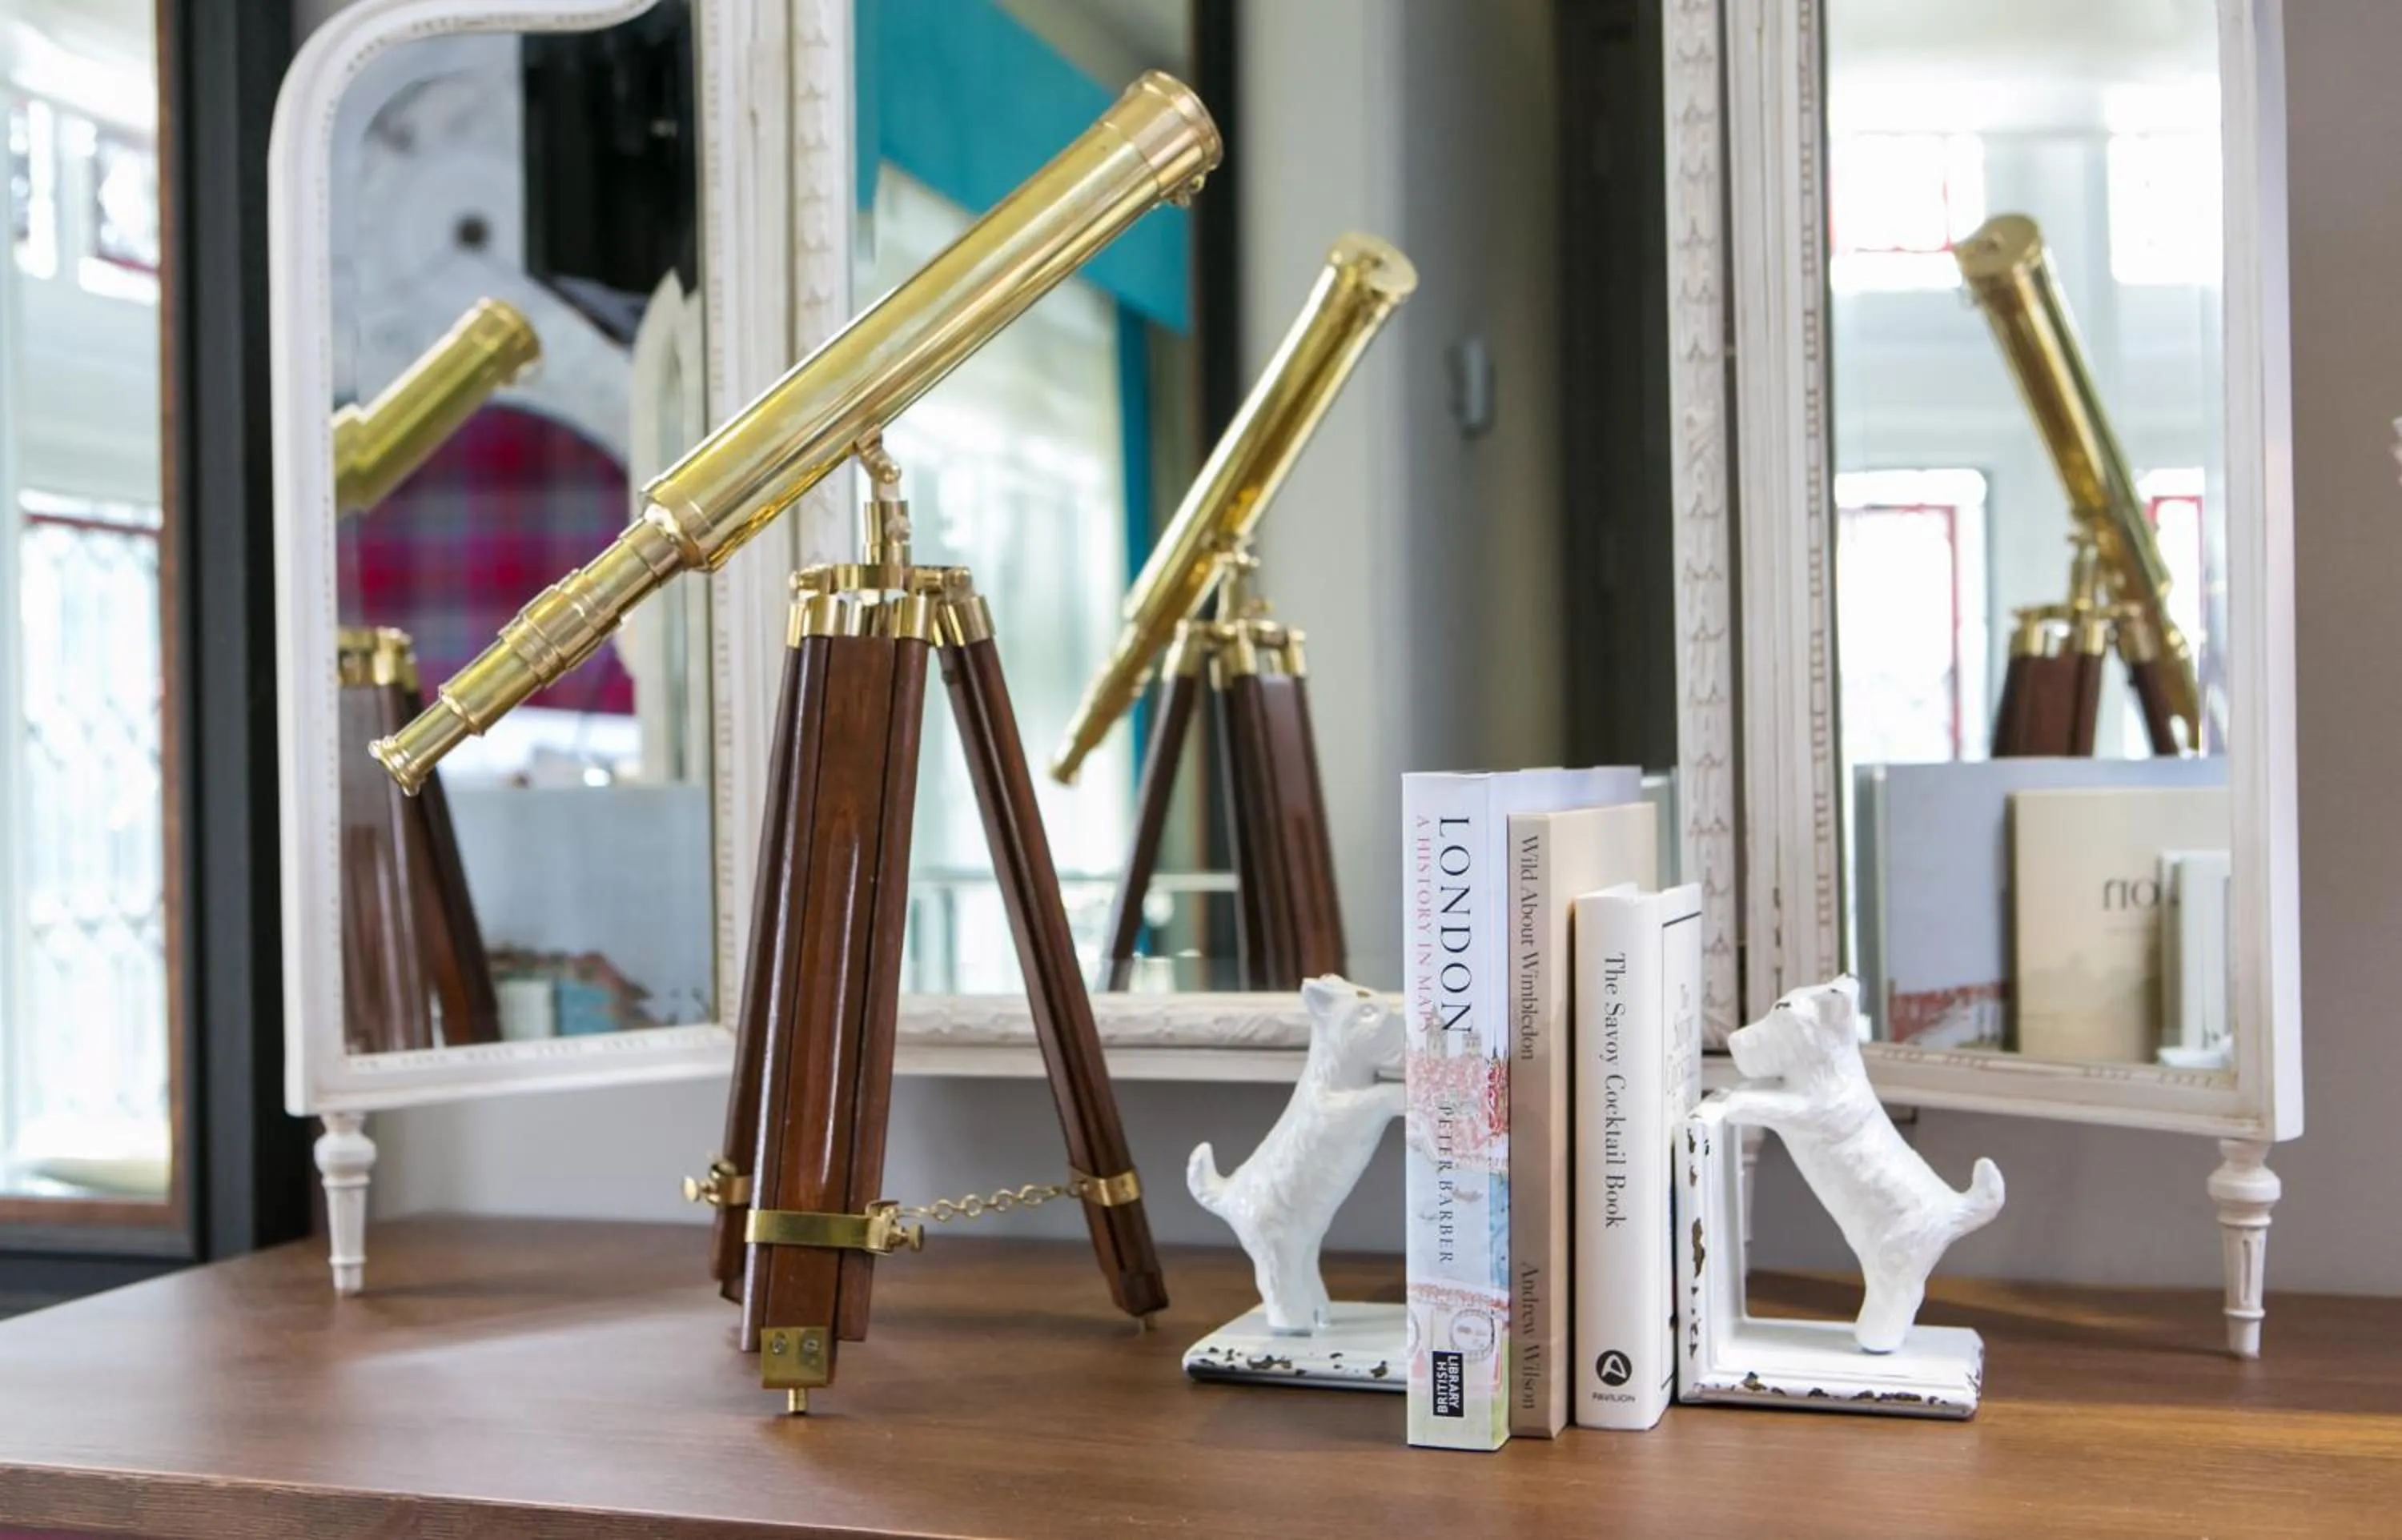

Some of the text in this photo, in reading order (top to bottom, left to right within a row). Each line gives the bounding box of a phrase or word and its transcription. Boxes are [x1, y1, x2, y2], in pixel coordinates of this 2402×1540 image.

[1416, 815, 1433, 1033] A HISTORY IN MAPS
[1439, 816, 1472, 1033] LONDON
[1520, 835, 1539, 1060] Wild About Wimbledon
[1599, 952, 1627, 1228] The Savoy Cocktail Book
[1438, 1106, 1454, 1263] PETER BARBER
[1436, 1362, 1448, 1414] BRITISH
[1448, 1355, 1460, 1409] LIBRARY
[1522, 1261, 1540, 1409] Andrew Wilson
